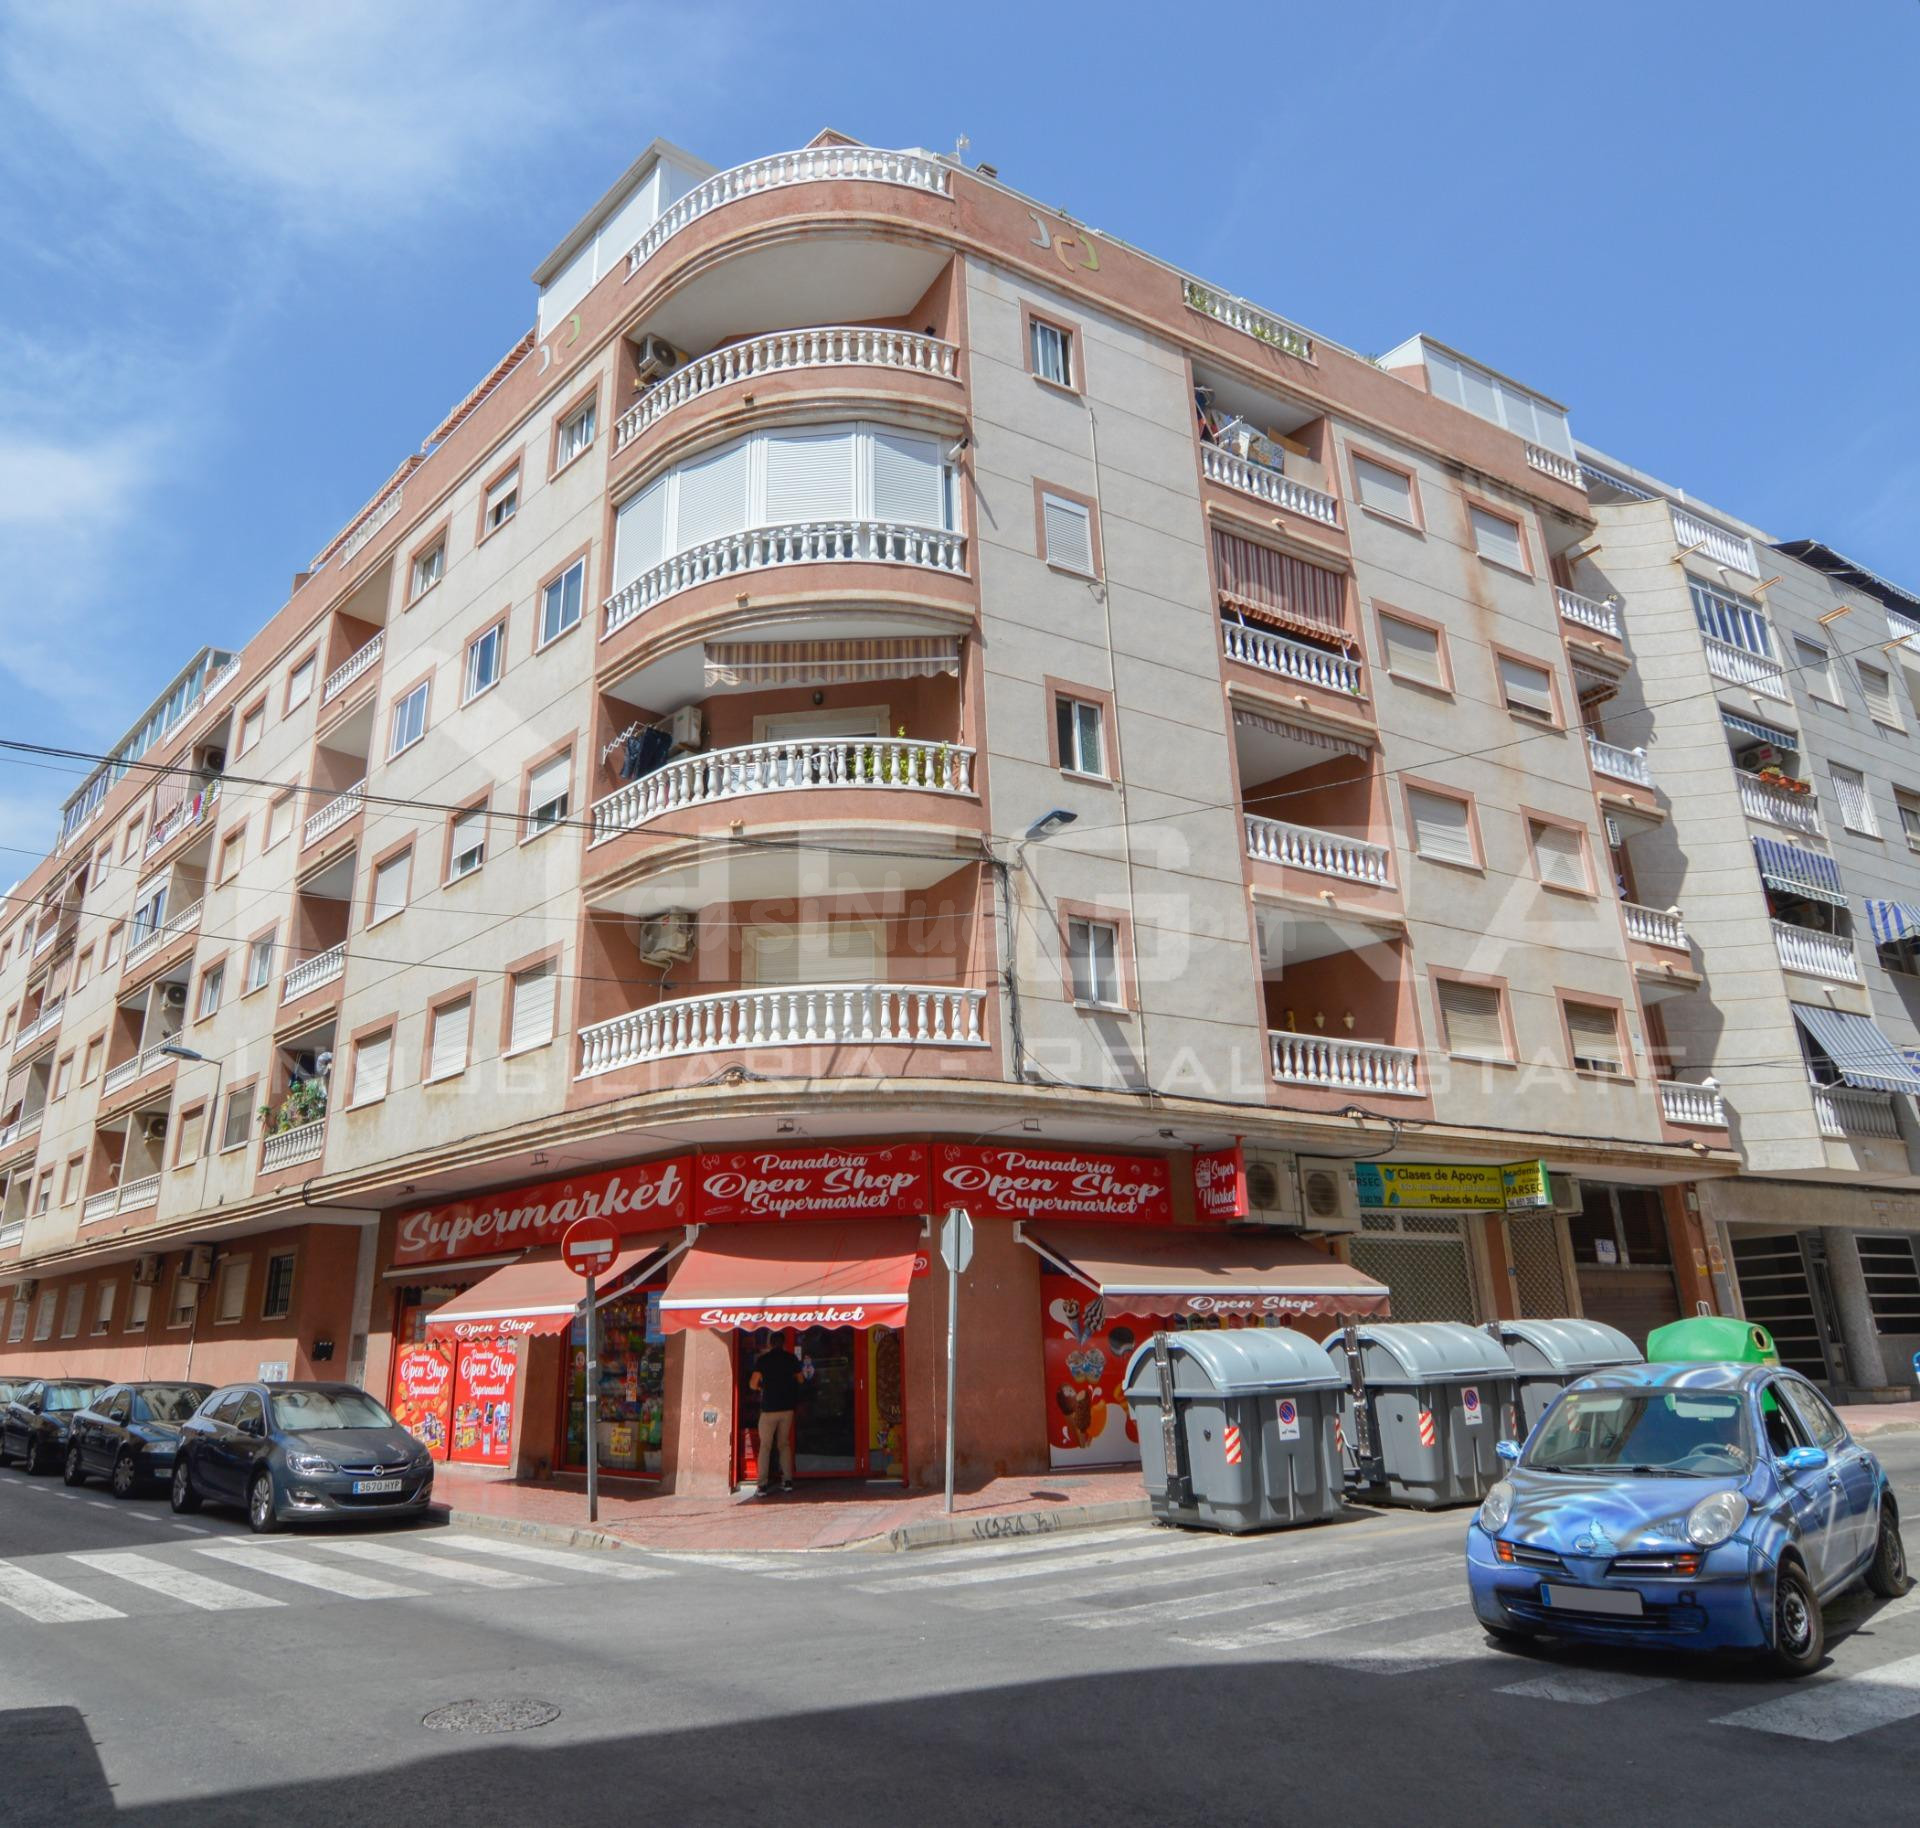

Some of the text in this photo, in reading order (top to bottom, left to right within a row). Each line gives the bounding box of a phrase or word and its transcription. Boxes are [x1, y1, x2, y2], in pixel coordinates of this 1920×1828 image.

[1211, 1160, 1235, 1183] Super
[1397, 1168, 1486, 1183] Clases de Apoyo
[703, 1168, 920, 1202] Open Shop
[943, 1165, 1165, 1204] Open Shop
[1505, 1183, 1544, 1196] PARSEC
[749, 1190, 889, 1218] Supermarket
[996, 1189, 1140, 1216] Supermarket
[1199, 1185, 1236, 1208] Market
[1464, 1195, 1474, 1204] de
[400, 1165, 683, 1254] Supermarket
[1187, 1296, 1317, 1312] Open Shop
[699, 1306, 865, 1327] Supermarket
[454, 1320, 536, 1337] Open Shop
[401, 1358, 449, 1384] Open Shop
[461, 1356, 516, 1384] Open Shop
[360, 1480, 400, 1492] 3670 HYP
